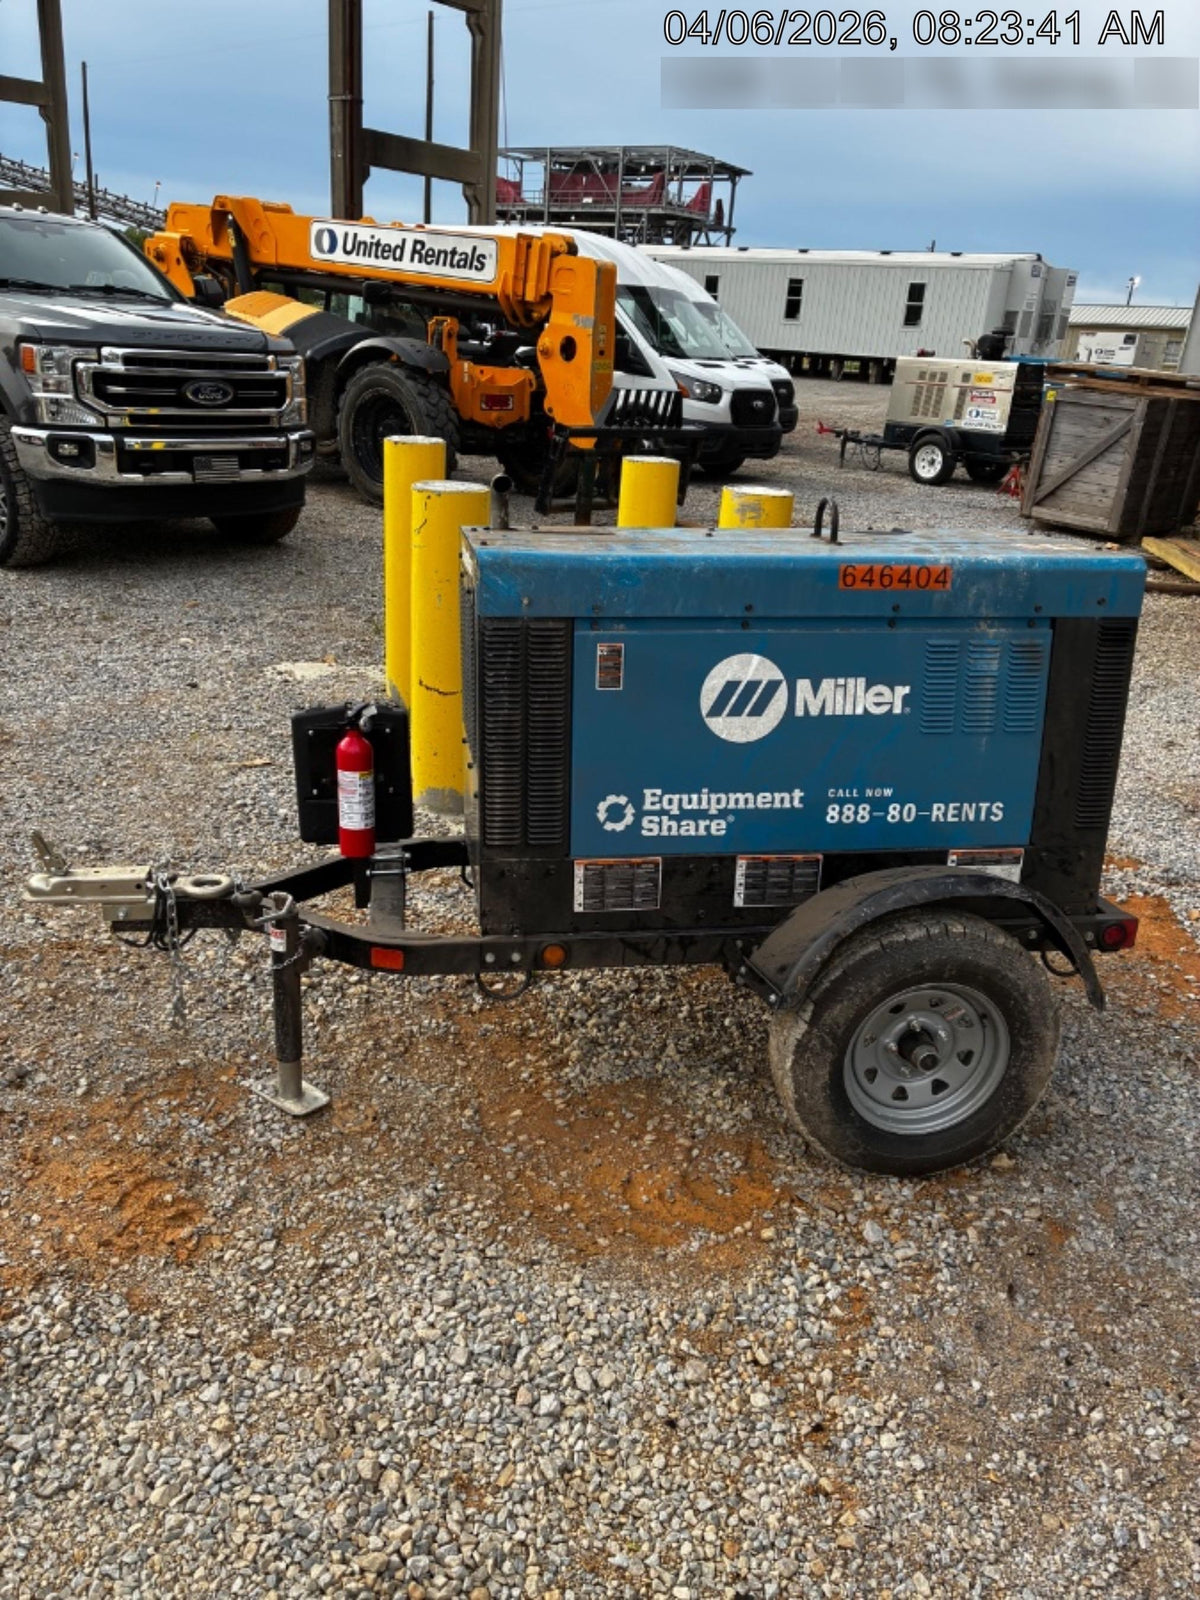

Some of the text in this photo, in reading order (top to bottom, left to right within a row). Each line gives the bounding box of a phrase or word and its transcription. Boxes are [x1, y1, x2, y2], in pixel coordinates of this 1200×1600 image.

[341, 231, 487, 272] United Rentals
[842, 564, 948, 589] 646404
[794, 677, 911, 717] Miller
[642, 788, 805, 815] Equipment
[827, 788, 894, 798] CALL NOW
[825, 802, 1005, 824] 888-80-RENTS
